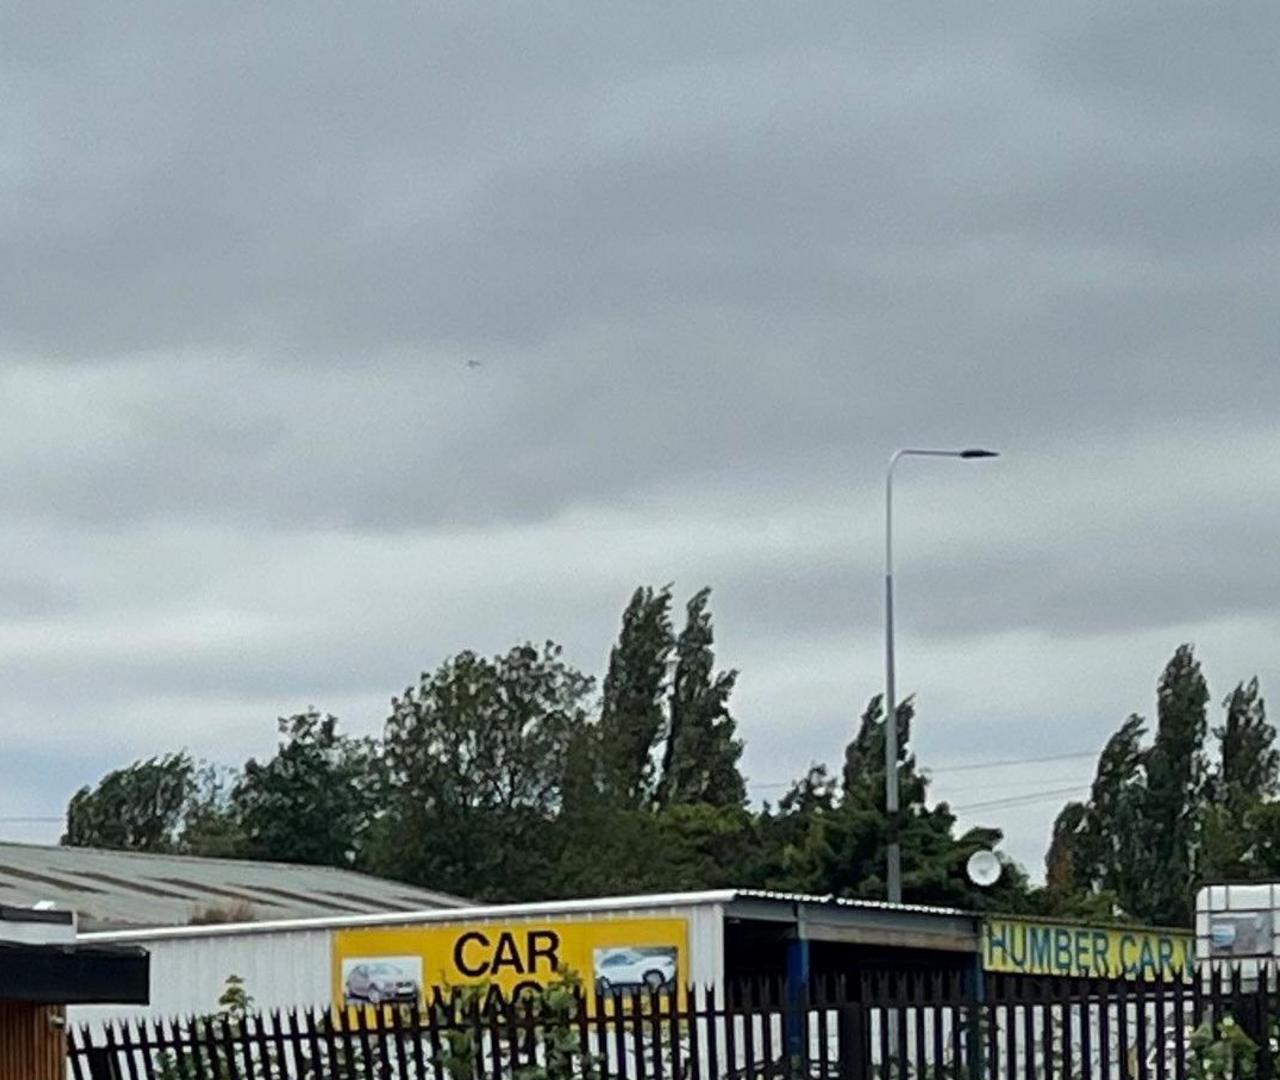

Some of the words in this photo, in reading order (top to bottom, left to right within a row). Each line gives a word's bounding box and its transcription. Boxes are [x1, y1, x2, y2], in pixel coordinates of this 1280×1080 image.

[453, 931, 561, 977] CAR
[989, 923, 1111, 974] HUMBER
[1119, 935, 1176, 976] CAR
